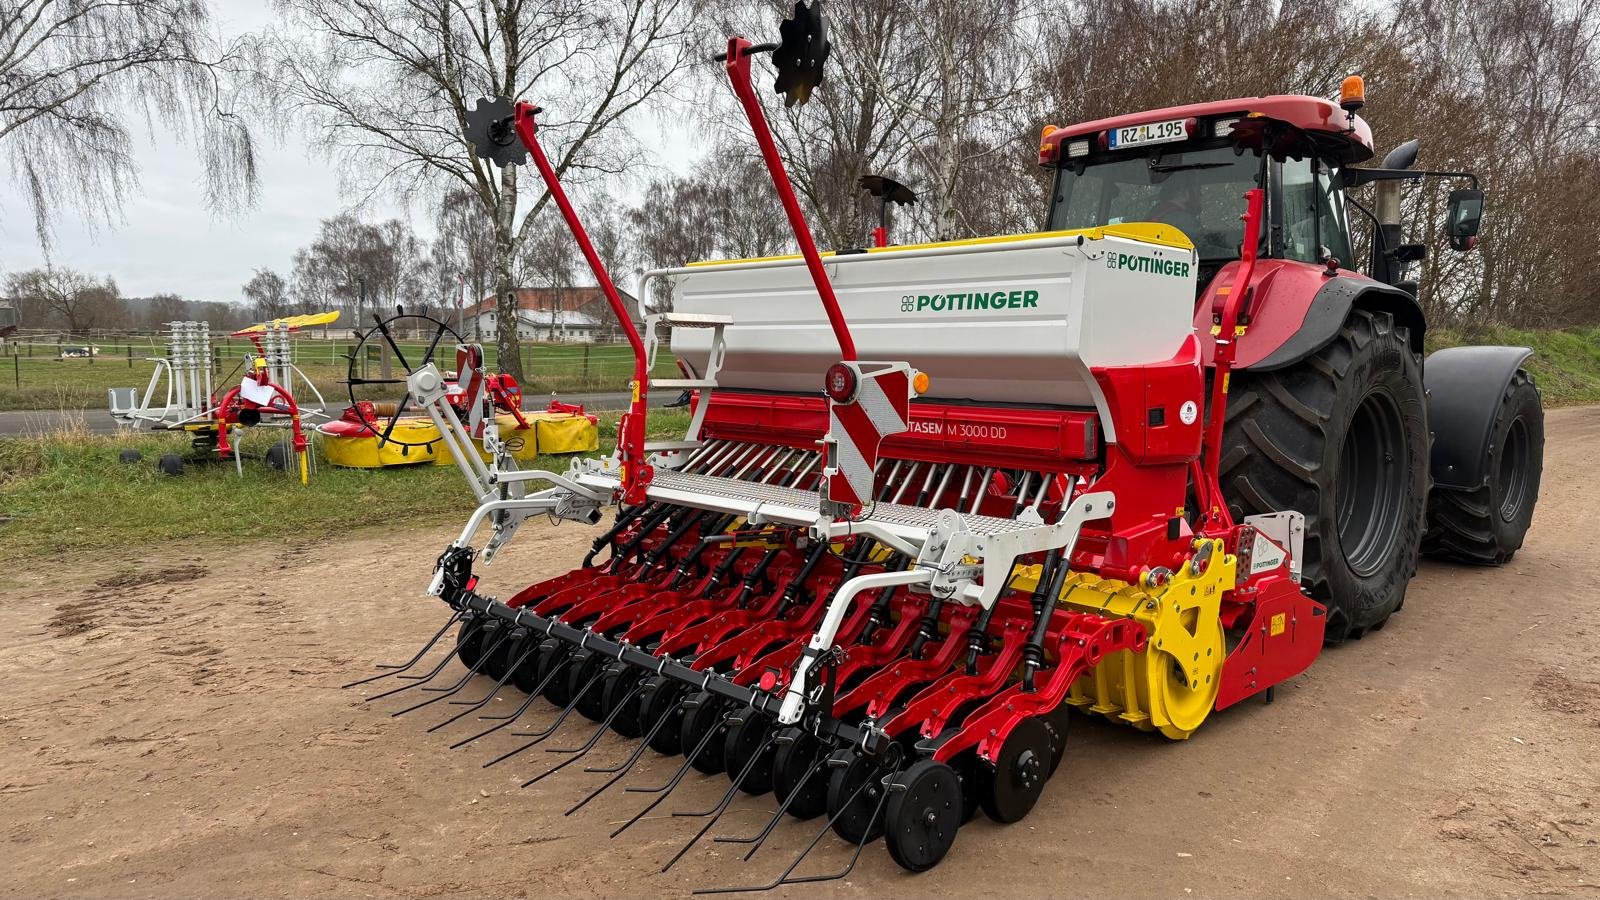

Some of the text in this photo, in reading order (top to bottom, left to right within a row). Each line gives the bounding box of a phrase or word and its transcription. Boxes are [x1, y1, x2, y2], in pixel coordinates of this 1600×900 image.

[1121, 128, 1138, 143] RZ
[1146, 126, 1155, 139] L
[1157, 121, 1182, 138] 195
[916, 290, 1039, 311] PÖTTINGER
[908, 421, 1007, 439] TASEM M 3000 DD
